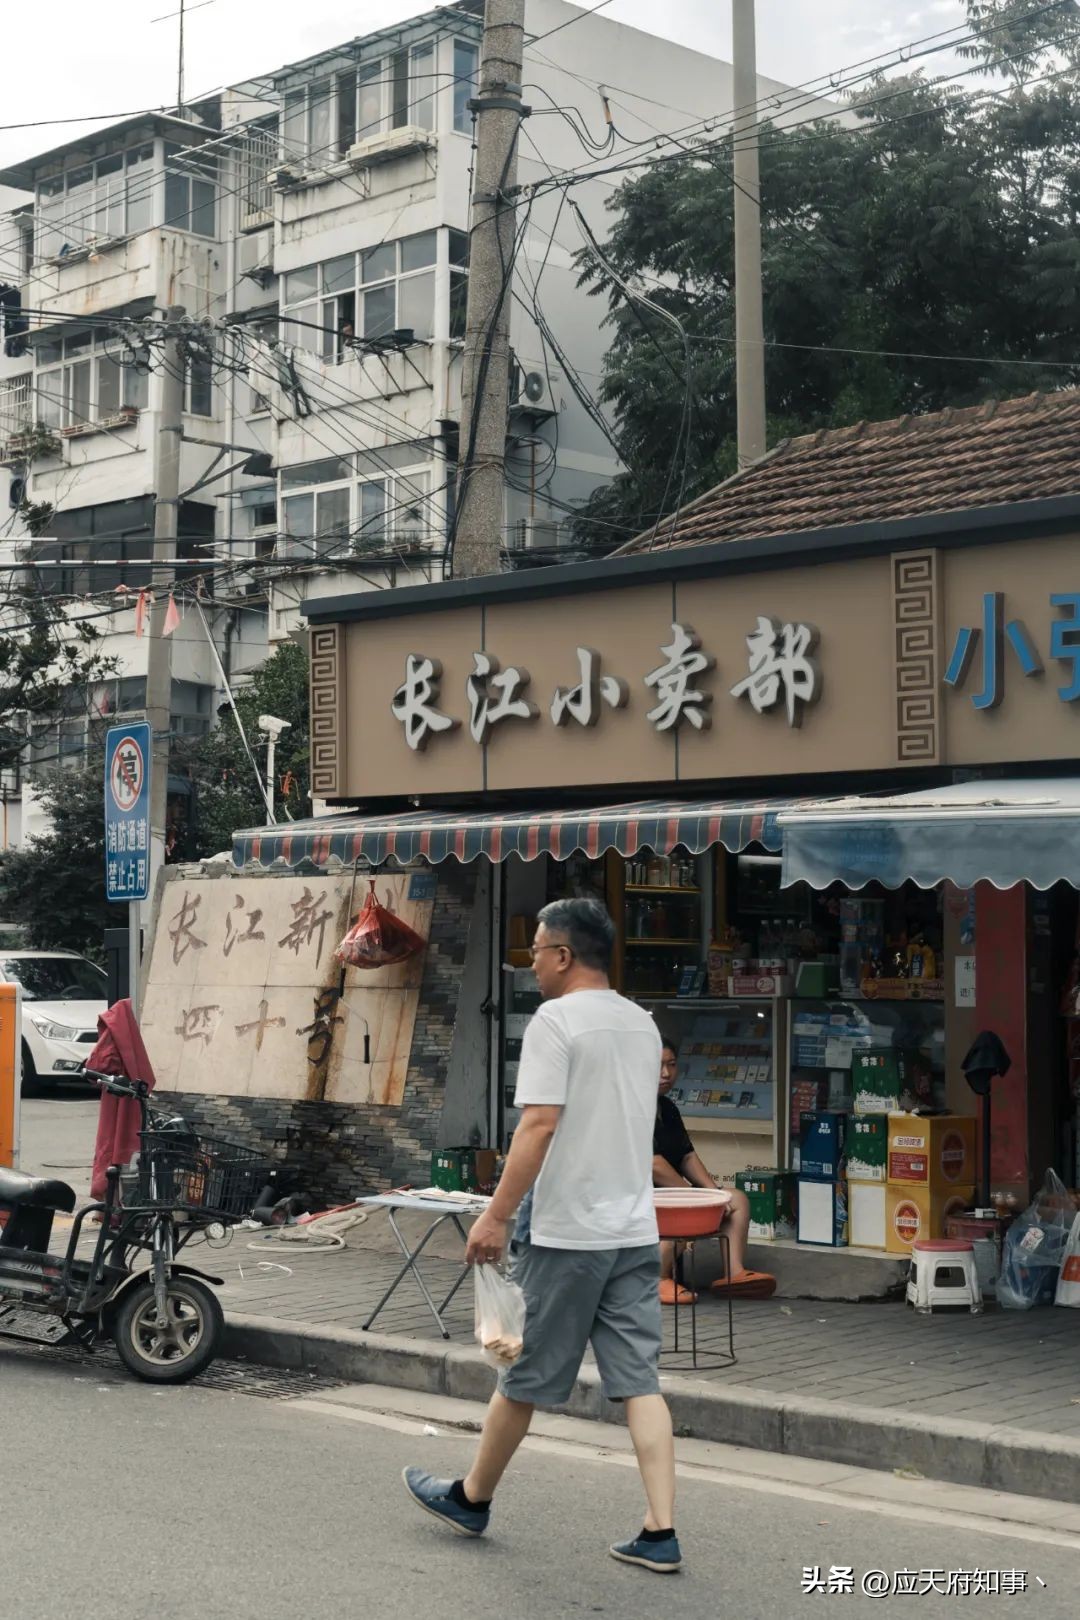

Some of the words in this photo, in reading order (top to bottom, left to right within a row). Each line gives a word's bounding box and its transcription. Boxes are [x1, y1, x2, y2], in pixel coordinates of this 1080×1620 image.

[391, 616, 818, 751] 长江小卖部
[116, 750, 137, 798] 停
[108, 818, 147, 853] 消防通道
[108, 858, 146, 893] 禁止占用
[168, 886, 396, 969] 长江新
